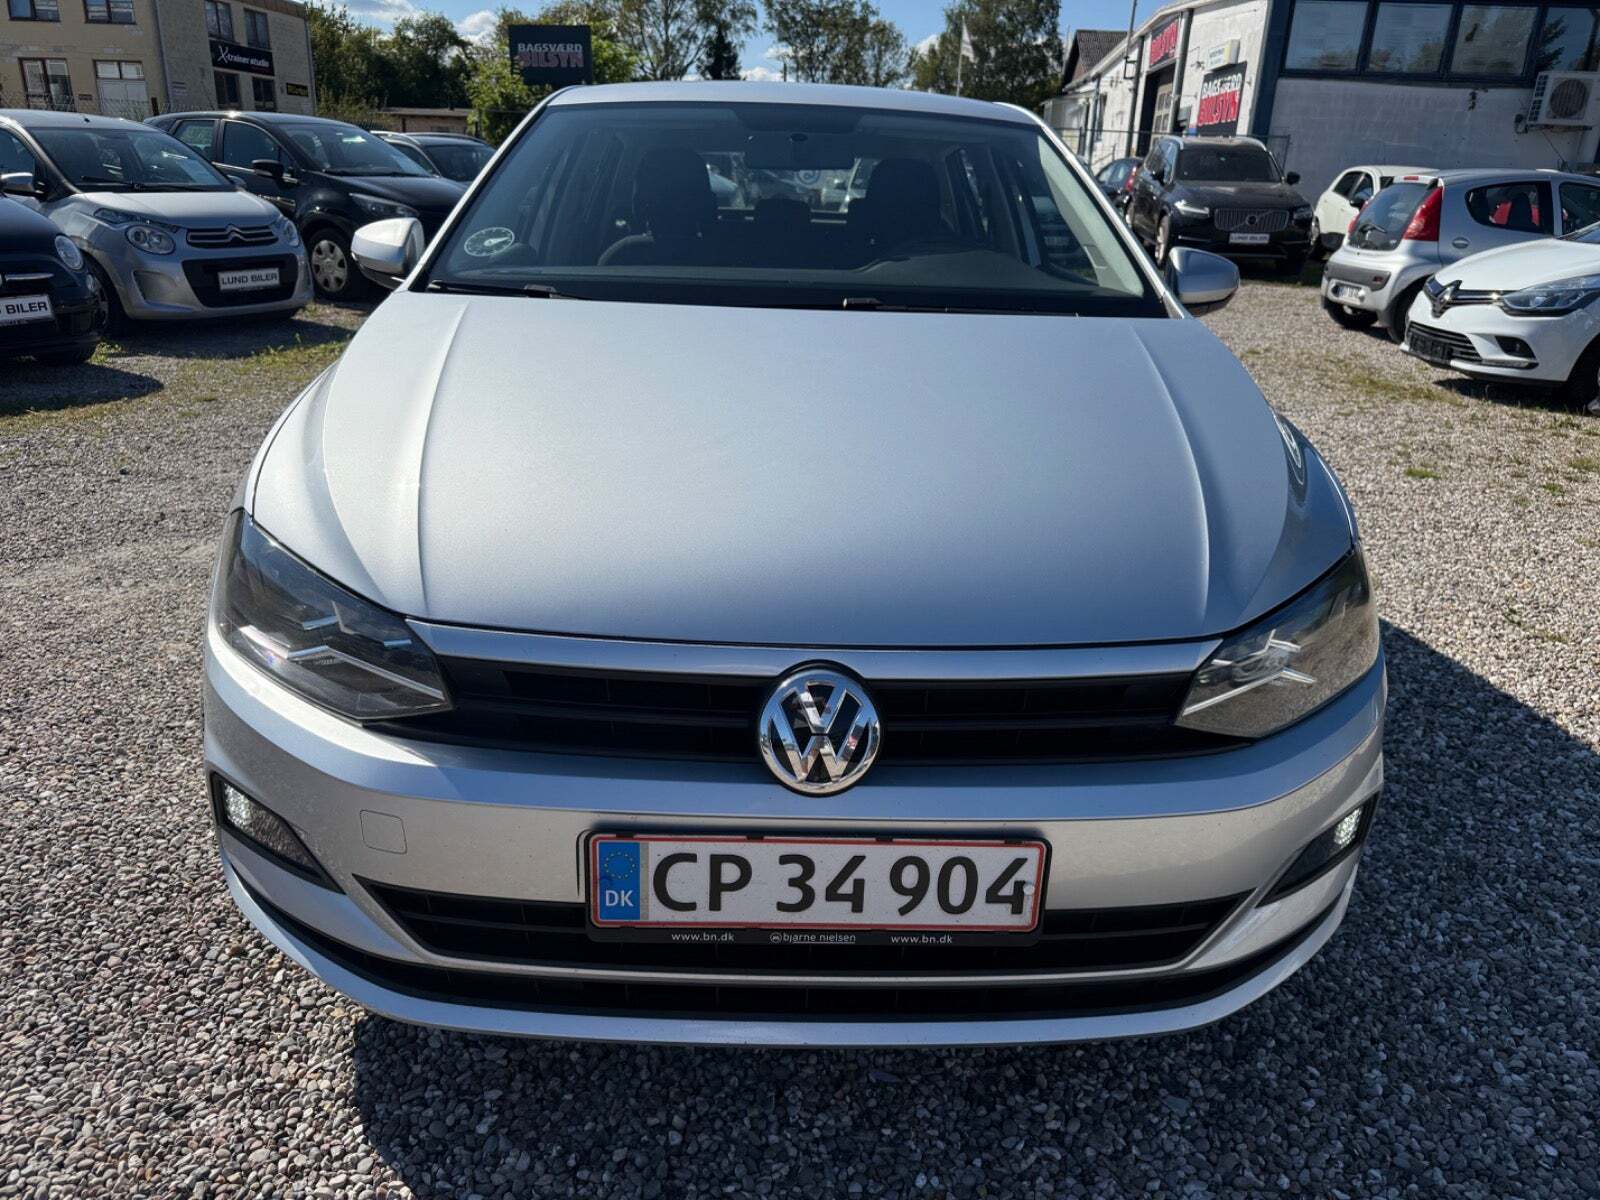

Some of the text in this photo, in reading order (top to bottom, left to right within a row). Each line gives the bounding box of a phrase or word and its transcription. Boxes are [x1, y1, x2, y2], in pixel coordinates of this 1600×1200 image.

[518, 43, 583, 53] BAGSVÆRD
[222, 272, 278, 285] LUND BILER
[5, 301, 48, 315] BILER
[652, 852, 1029, 916] CP 34 904
[604, 889, 633, 907] DK
[671, 931, 735, 942] www.bn.dk
[783, 932, 816, 944] bjarne
[819, 932, 856, 943] nielsen
[890, 933, 953, 944] www.bn.dk
